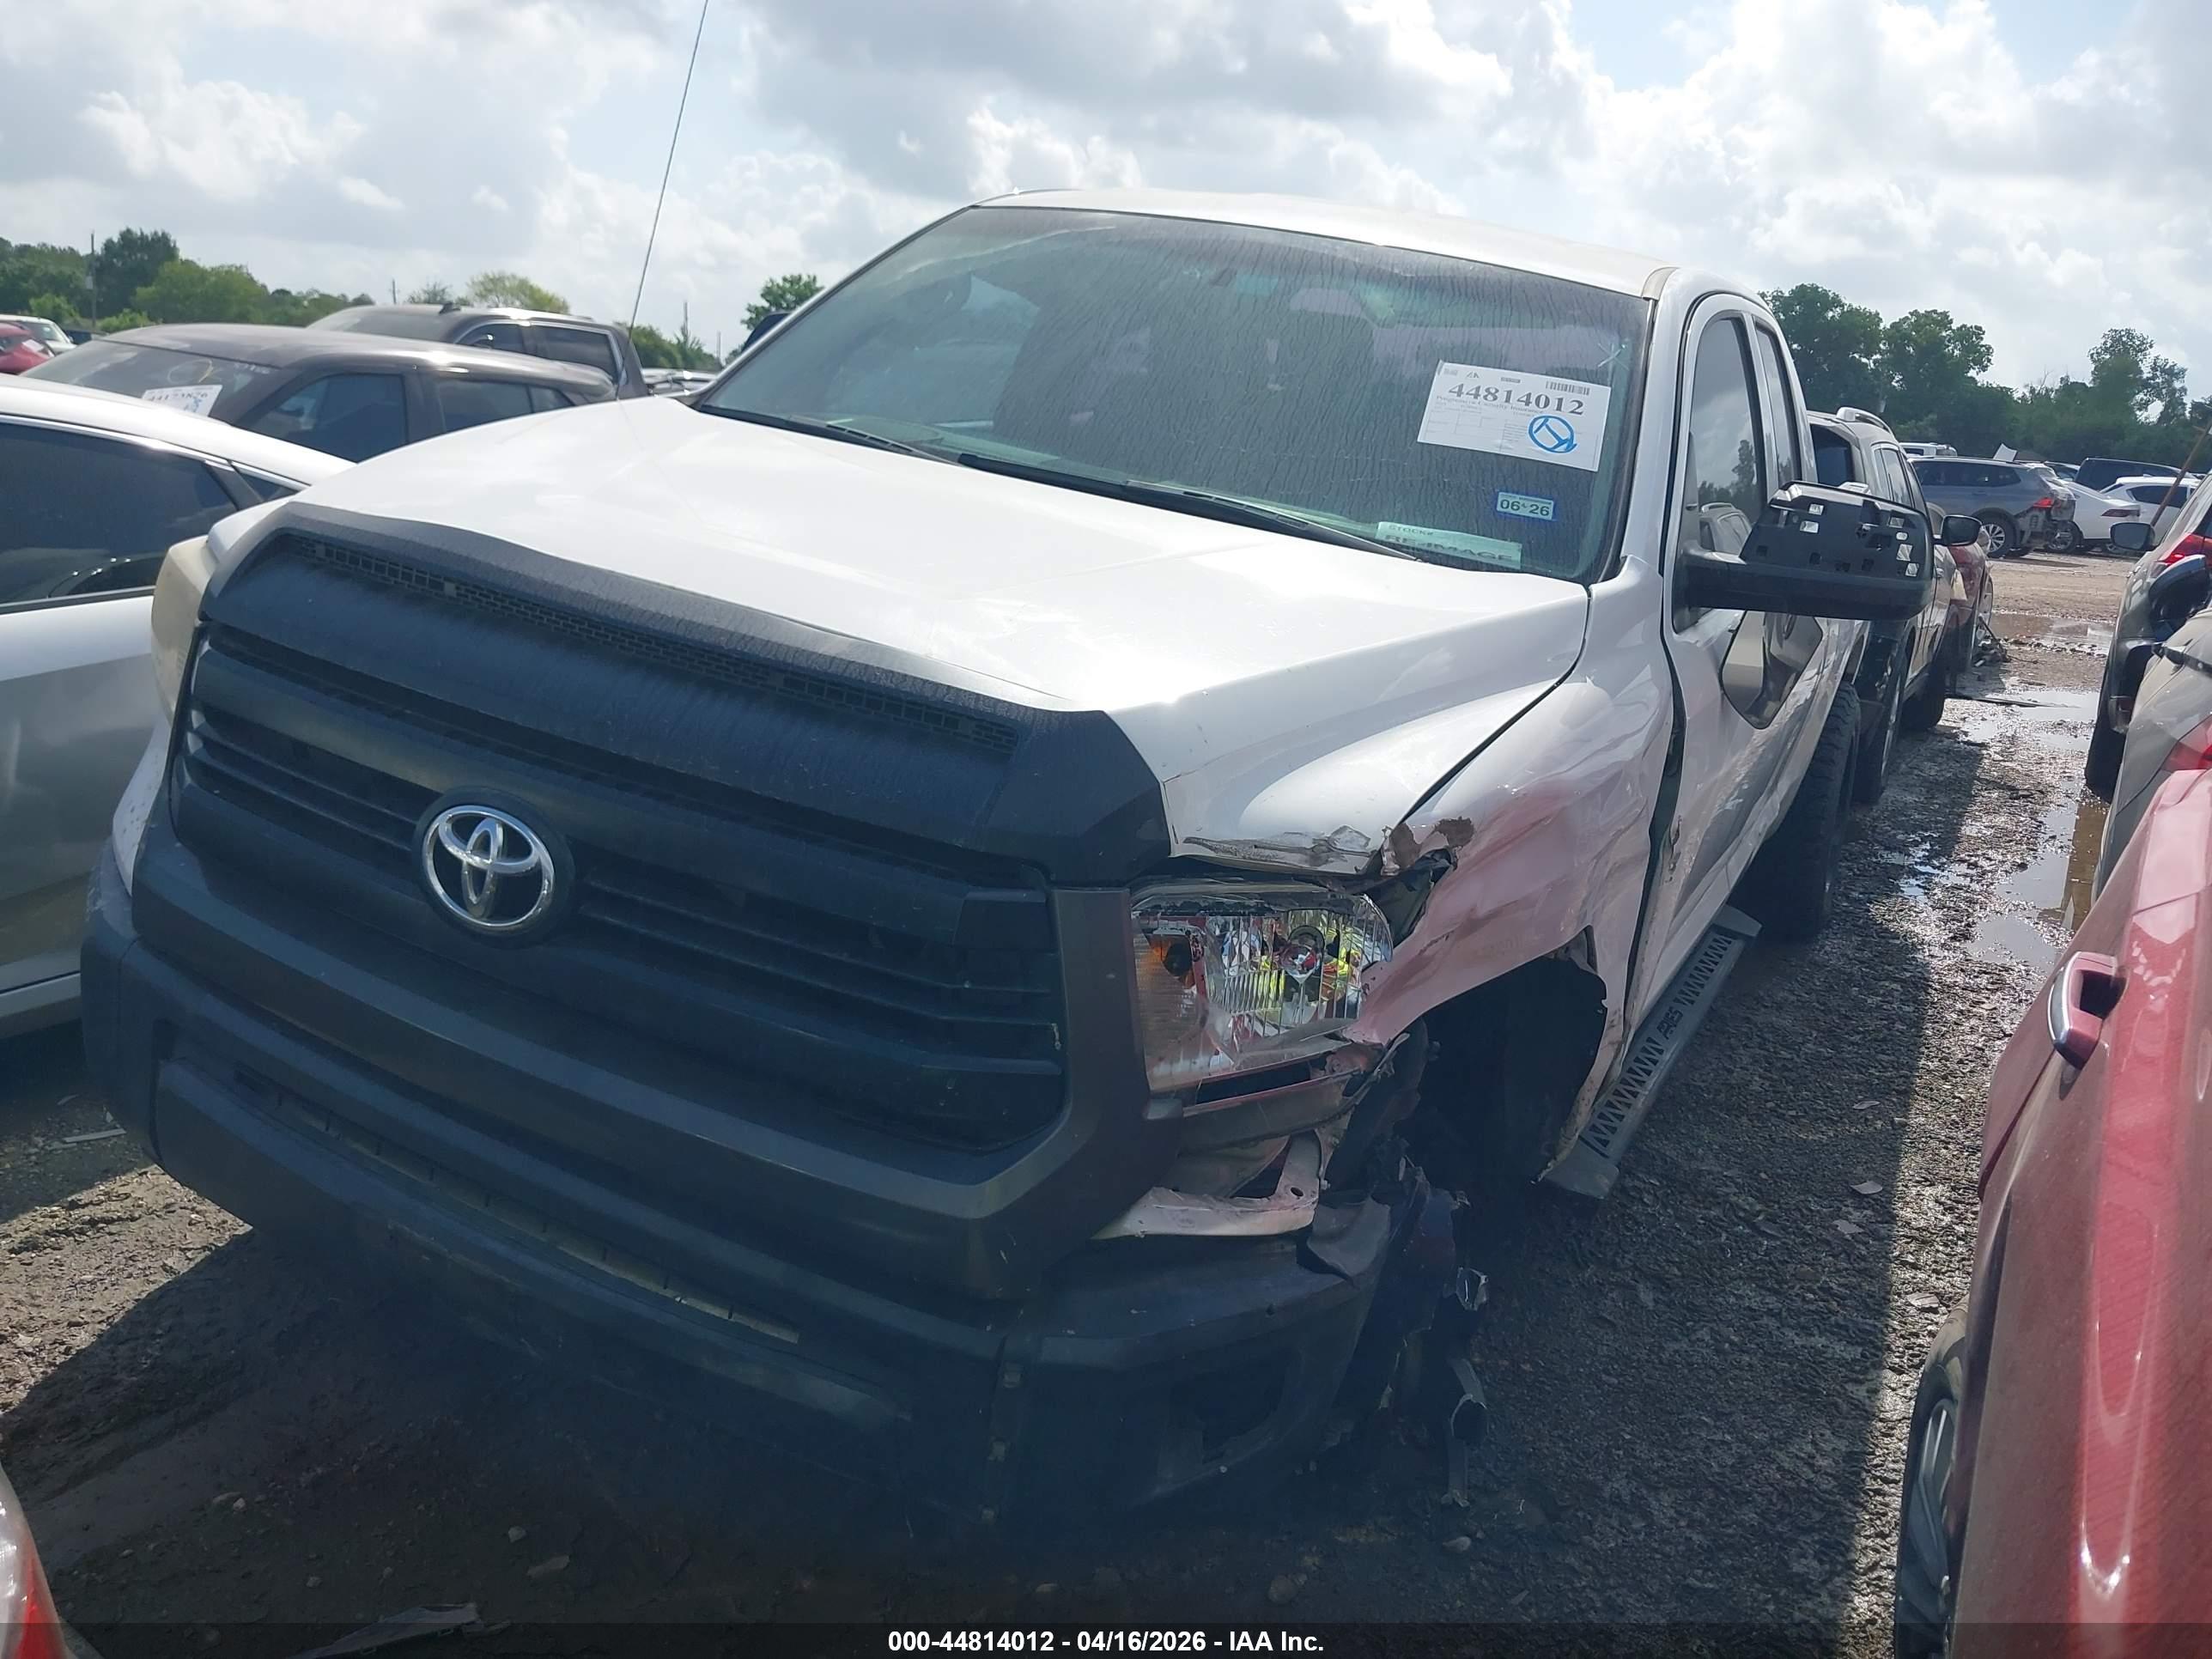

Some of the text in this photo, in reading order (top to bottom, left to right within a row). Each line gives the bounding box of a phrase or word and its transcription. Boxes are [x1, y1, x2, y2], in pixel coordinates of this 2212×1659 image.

[1448, 382, 1586, 416] 44814012
[1500, 499, 1521, 512] 06
[1529, 503, 1550, 517] 26
